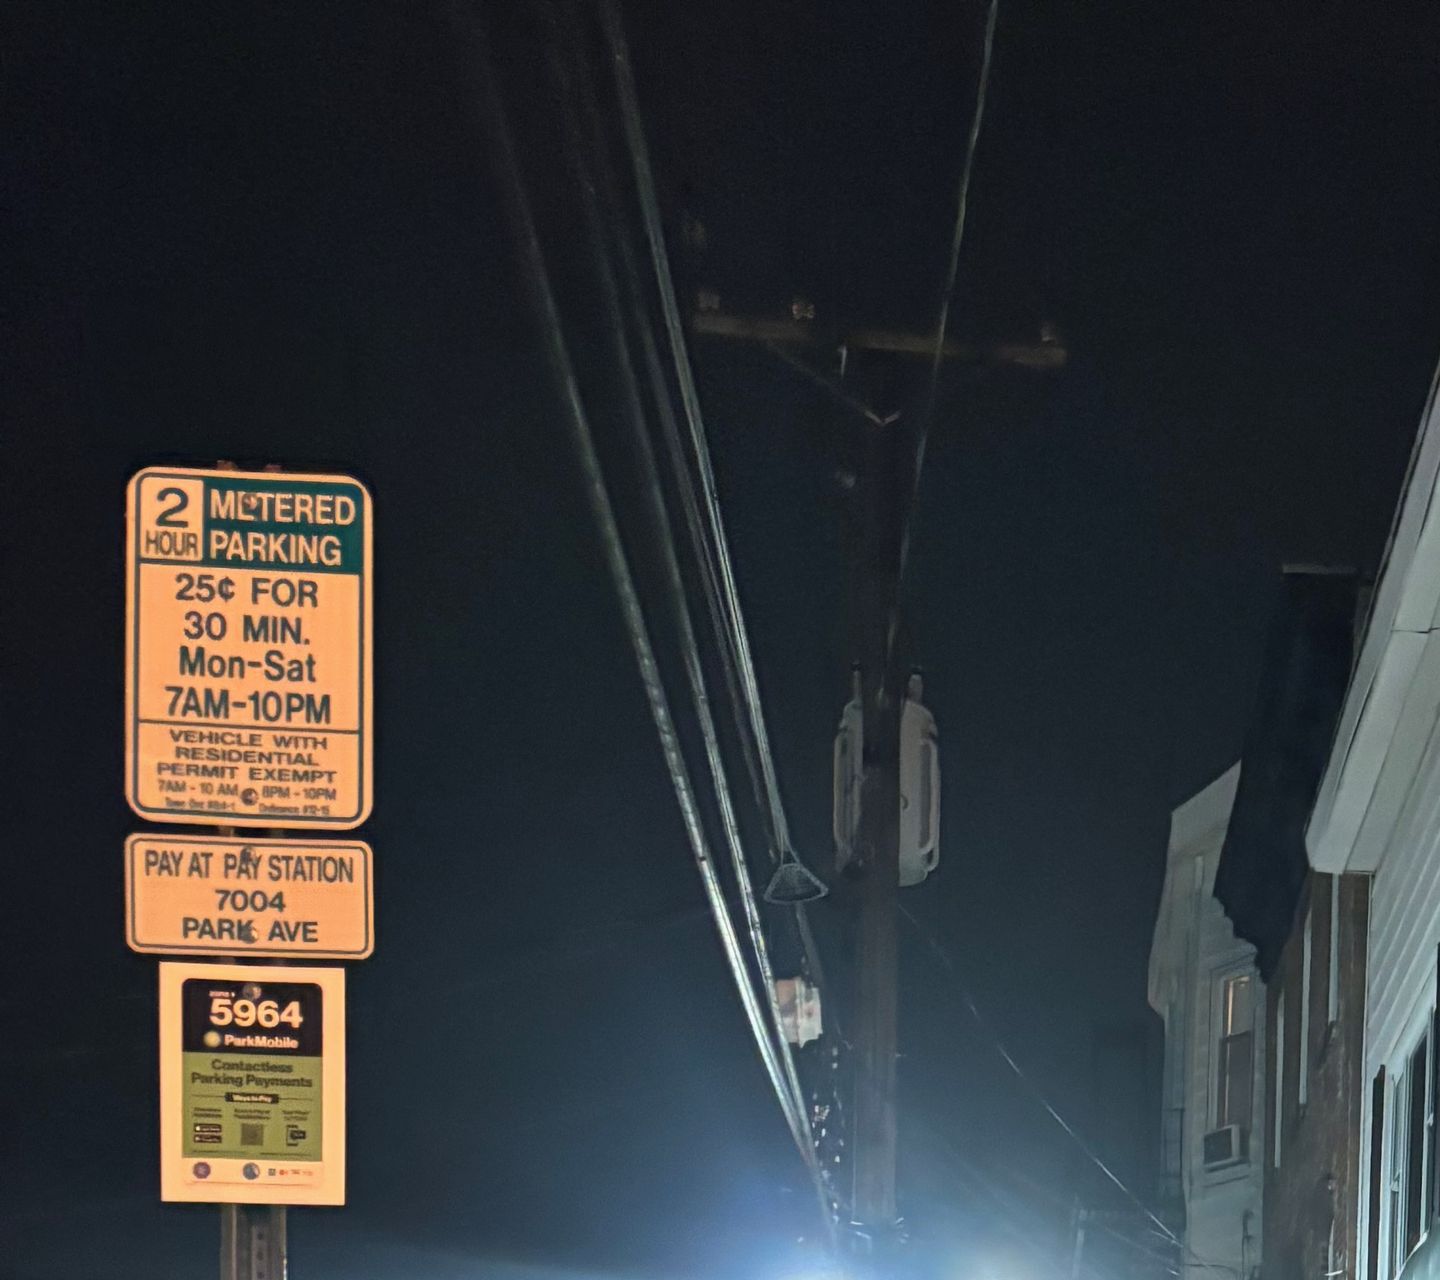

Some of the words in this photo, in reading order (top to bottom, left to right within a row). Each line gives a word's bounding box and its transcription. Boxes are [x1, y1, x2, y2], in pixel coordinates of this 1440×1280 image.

[156, 488, 189, 528] 2
[211, 489, 356, 525] METERED
[145, 531, 199, 557] HOUR
[210, 531, 342, 566] PARKING
[176, 573, 235, 603] 25¢
[251, 577, 318, 608] FOR
[184, 612, 227, 641] 30
[243, 615, 310, 645] MIN.
[179, 646, 317, 682] Mon-Sat
[165, 686, 331, 724] 7AM-10PM
[170, 729, 263, 747] VEHICLE
[273, 735, 327, 750] WITH
[175, 747, 319, 766] RESIDENTIAL
[157, 763, 239, 779] PERMIT
[249, 768, 337, 784] EXEMPT
[200, 782, 213, 794] 10
[218, 784, 239, 796] AM
[145, 849, 184, 877] PAY
[188, 851, 213, 878] AT
[224, 852, 262, 881] PAY
[268, 855, 353, 883] STATION
[215, 889, 287, 913] 7004
[183, 918, 256, 942] PARK
[268, 920, 318, 943] AVE
[209, 998, 303, 1029] 5964
[224, 1034, 299, 1050] ParkMobile
[211, 1059, 293, 1074] Contactless
[191, 1072, 243, 1088] Parking
[246, 1074, 313, 1089] Payments
